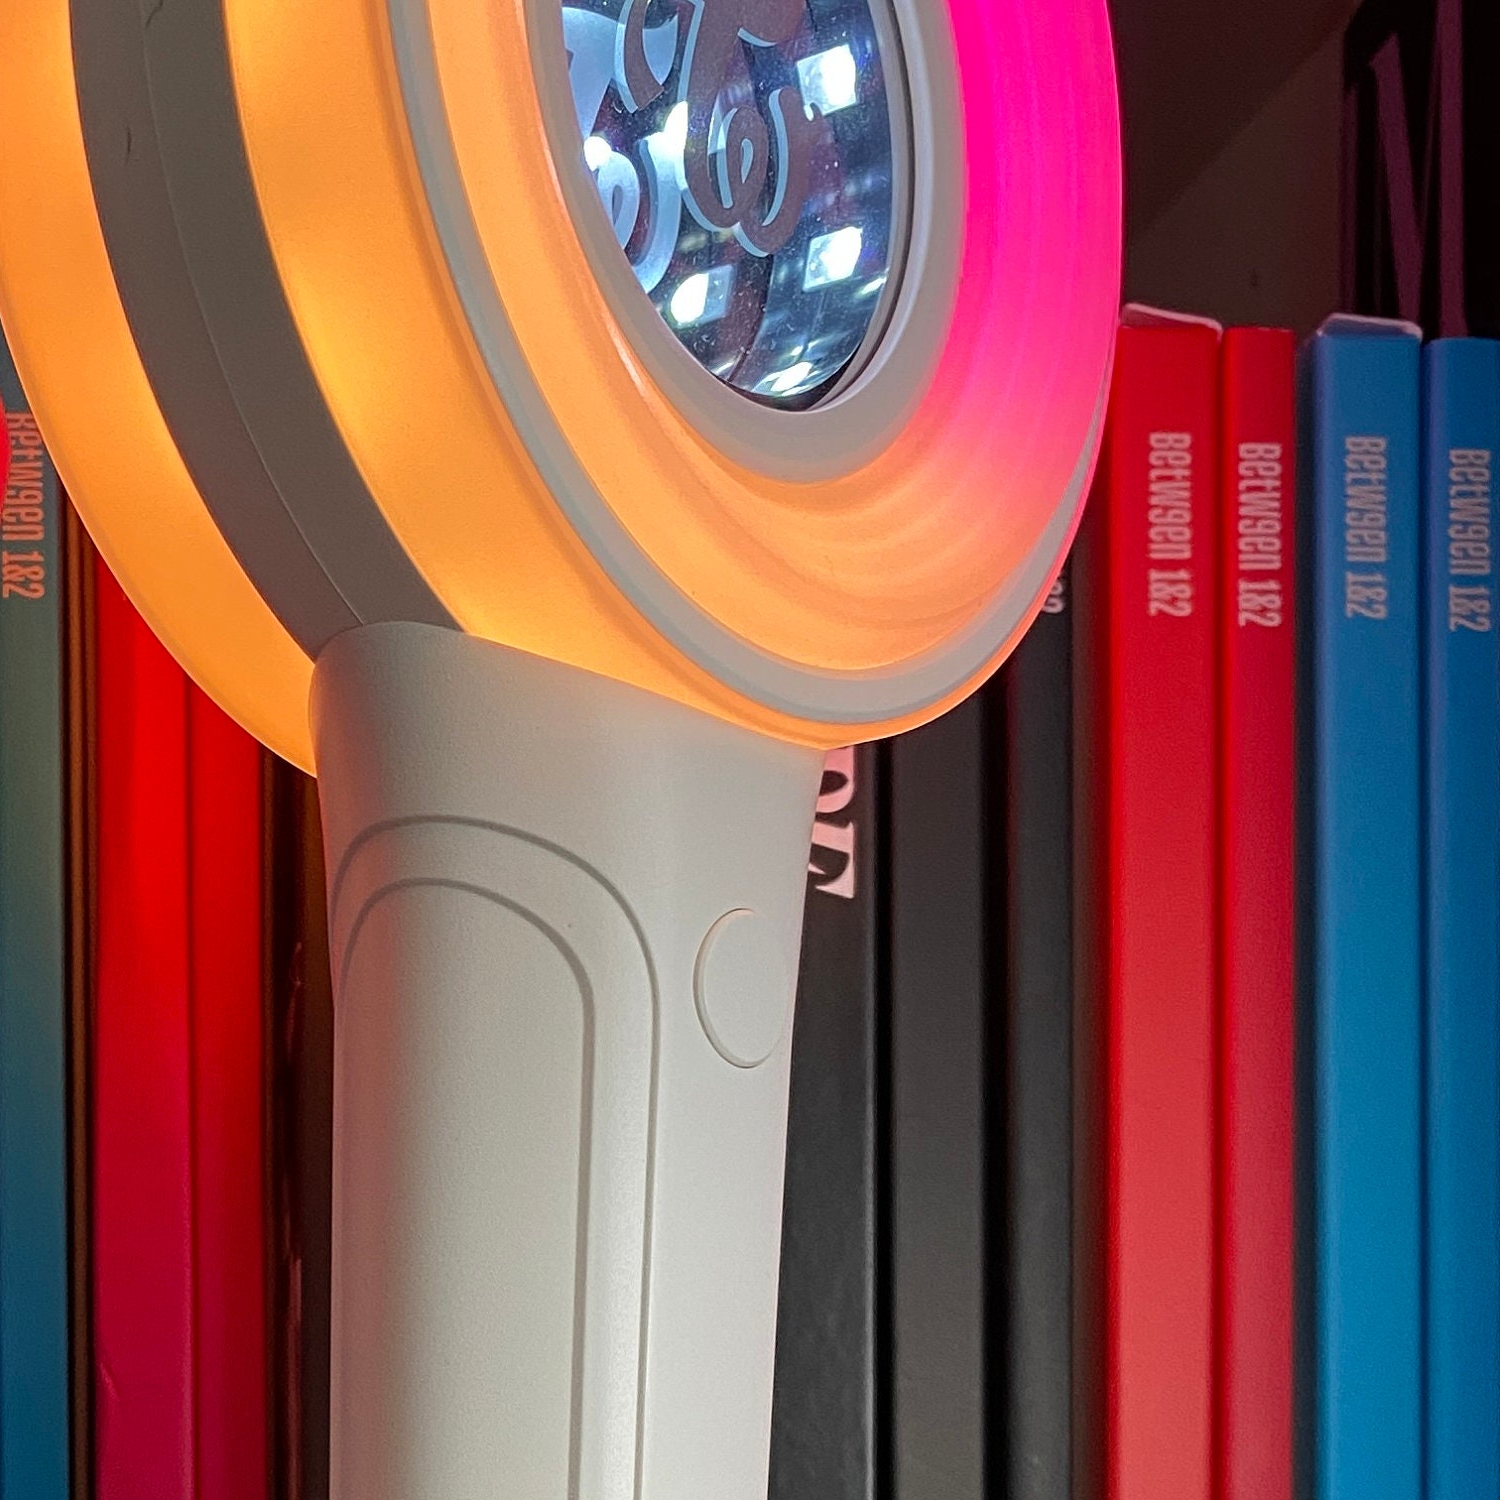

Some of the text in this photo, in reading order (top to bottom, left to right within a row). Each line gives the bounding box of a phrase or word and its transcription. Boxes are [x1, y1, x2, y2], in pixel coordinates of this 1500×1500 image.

[2, 550, 45, 599] 1&2
[1148, 568, 1192, 617] 1&2
[1345, 571, 1388, 620] 1&2
[1238, 578, 1282, 627] 1&2
[1448, 584, 1491, 633] 1&2
